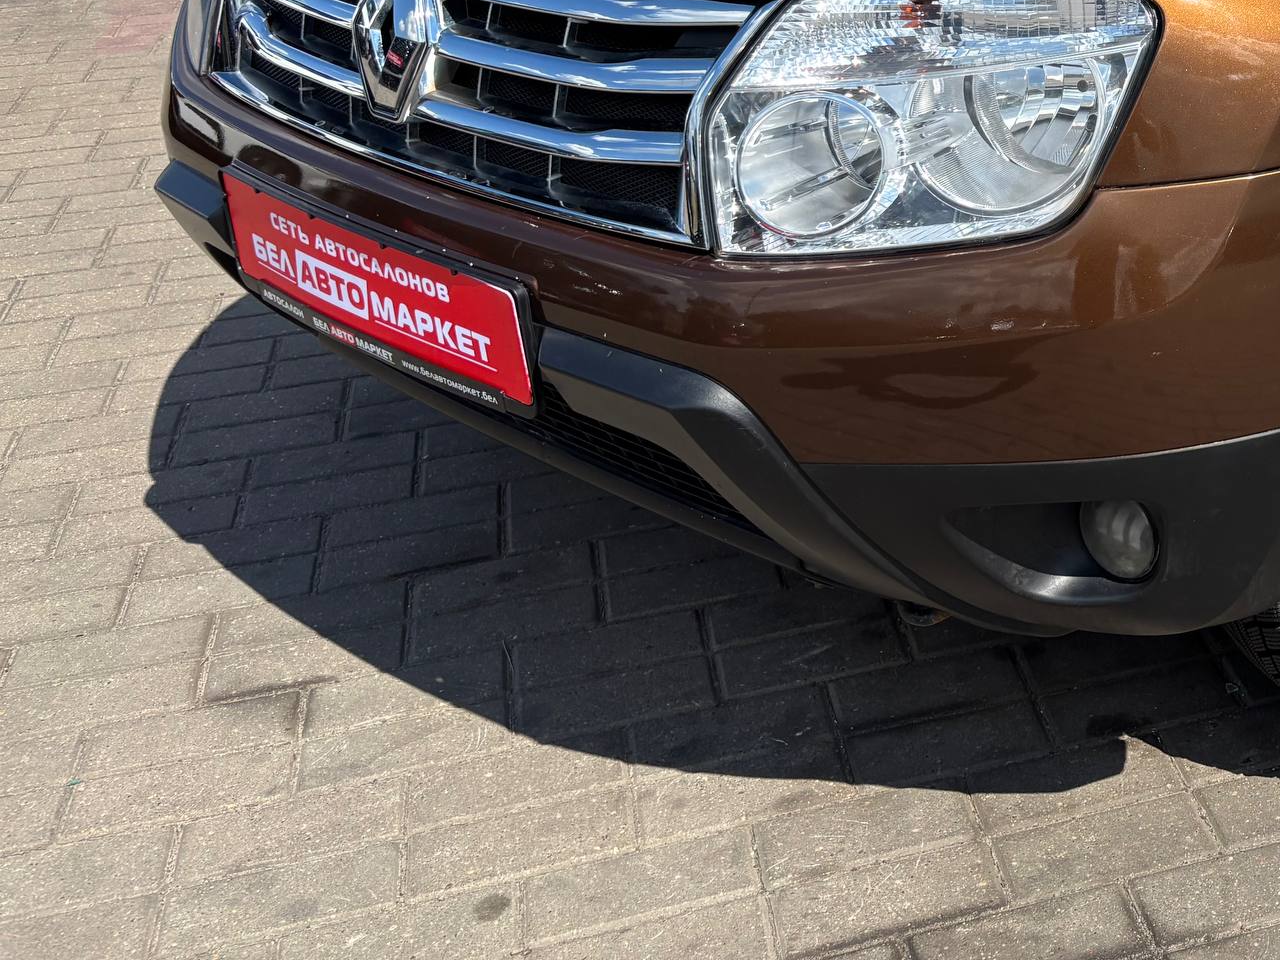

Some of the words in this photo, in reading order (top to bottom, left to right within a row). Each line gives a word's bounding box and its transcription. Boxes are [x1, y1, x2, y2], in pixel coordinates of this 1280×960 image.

[252, 233, 296, 280] БЕЛ
[300, 258, 367, 313] АВТО
[369, 290, 492, 363] МАРКЕТ
[269, 212, 310, 246] СЕТЬ
[314, 233, 451, 303] АВТОСАЛОНОВ
[263, 289, 305, 319] АВТОСАЛОН
